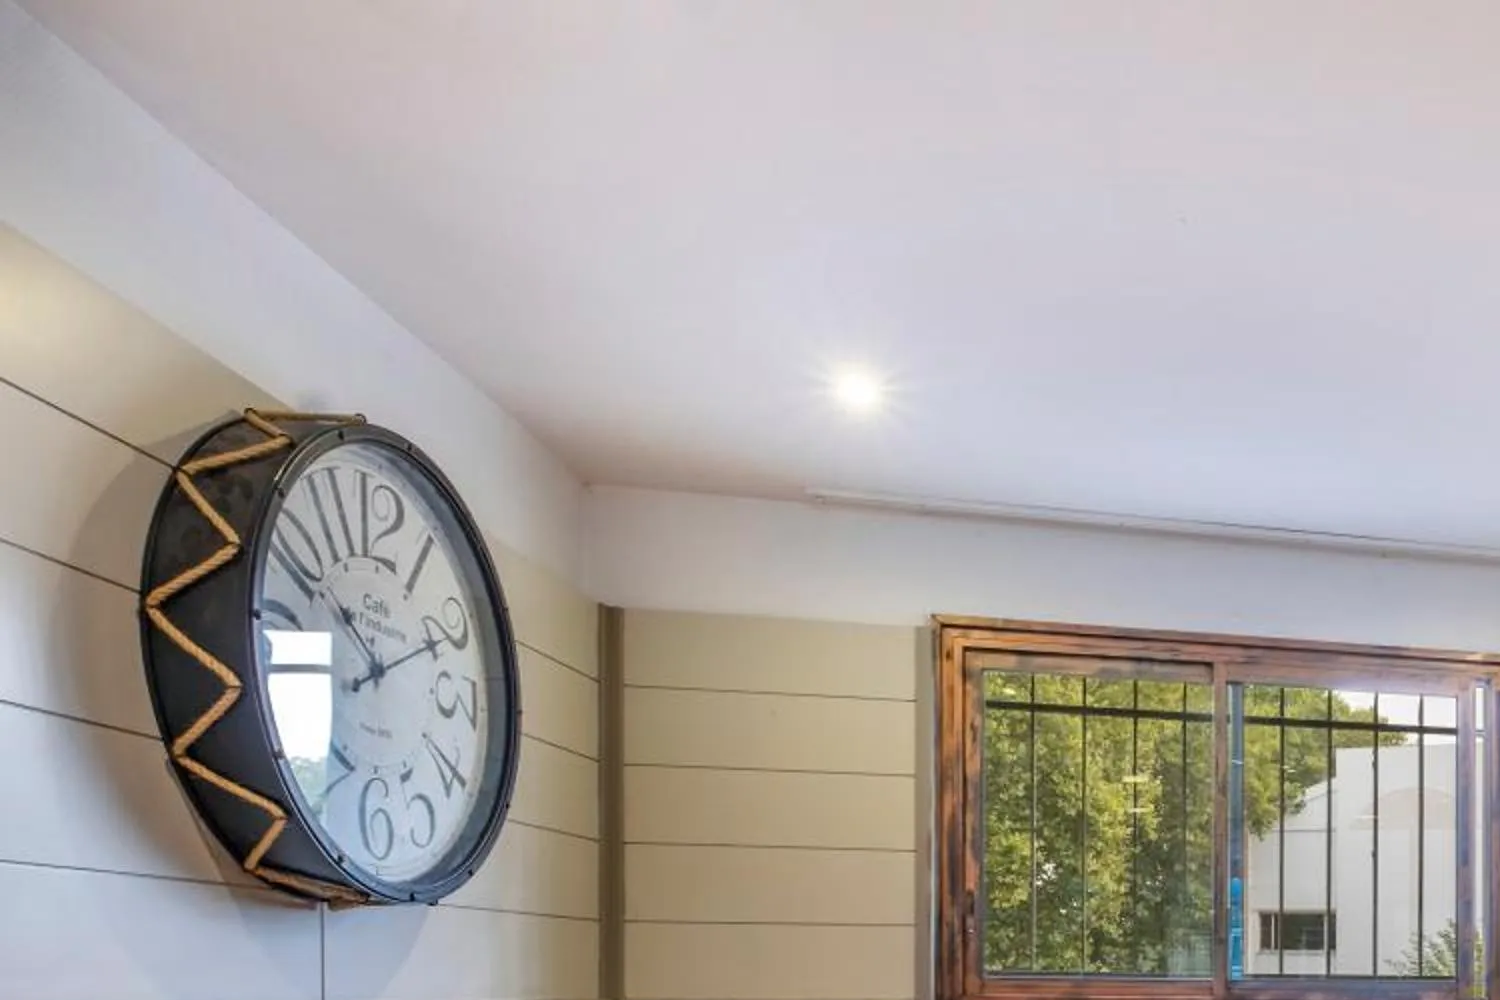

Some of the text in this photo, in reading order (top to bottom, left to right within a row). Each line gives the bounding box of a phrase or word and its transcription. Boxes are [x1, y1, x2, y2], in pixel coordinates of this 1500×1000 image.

[354, 468, 405, 576] 12
[421, 596, 469, 662] 2
[435, 669, 477, 732] 3
[424, 736, 467, 799] 4
[358, 777, 394, 861] 6
[400, 767, 436, 848] 5
